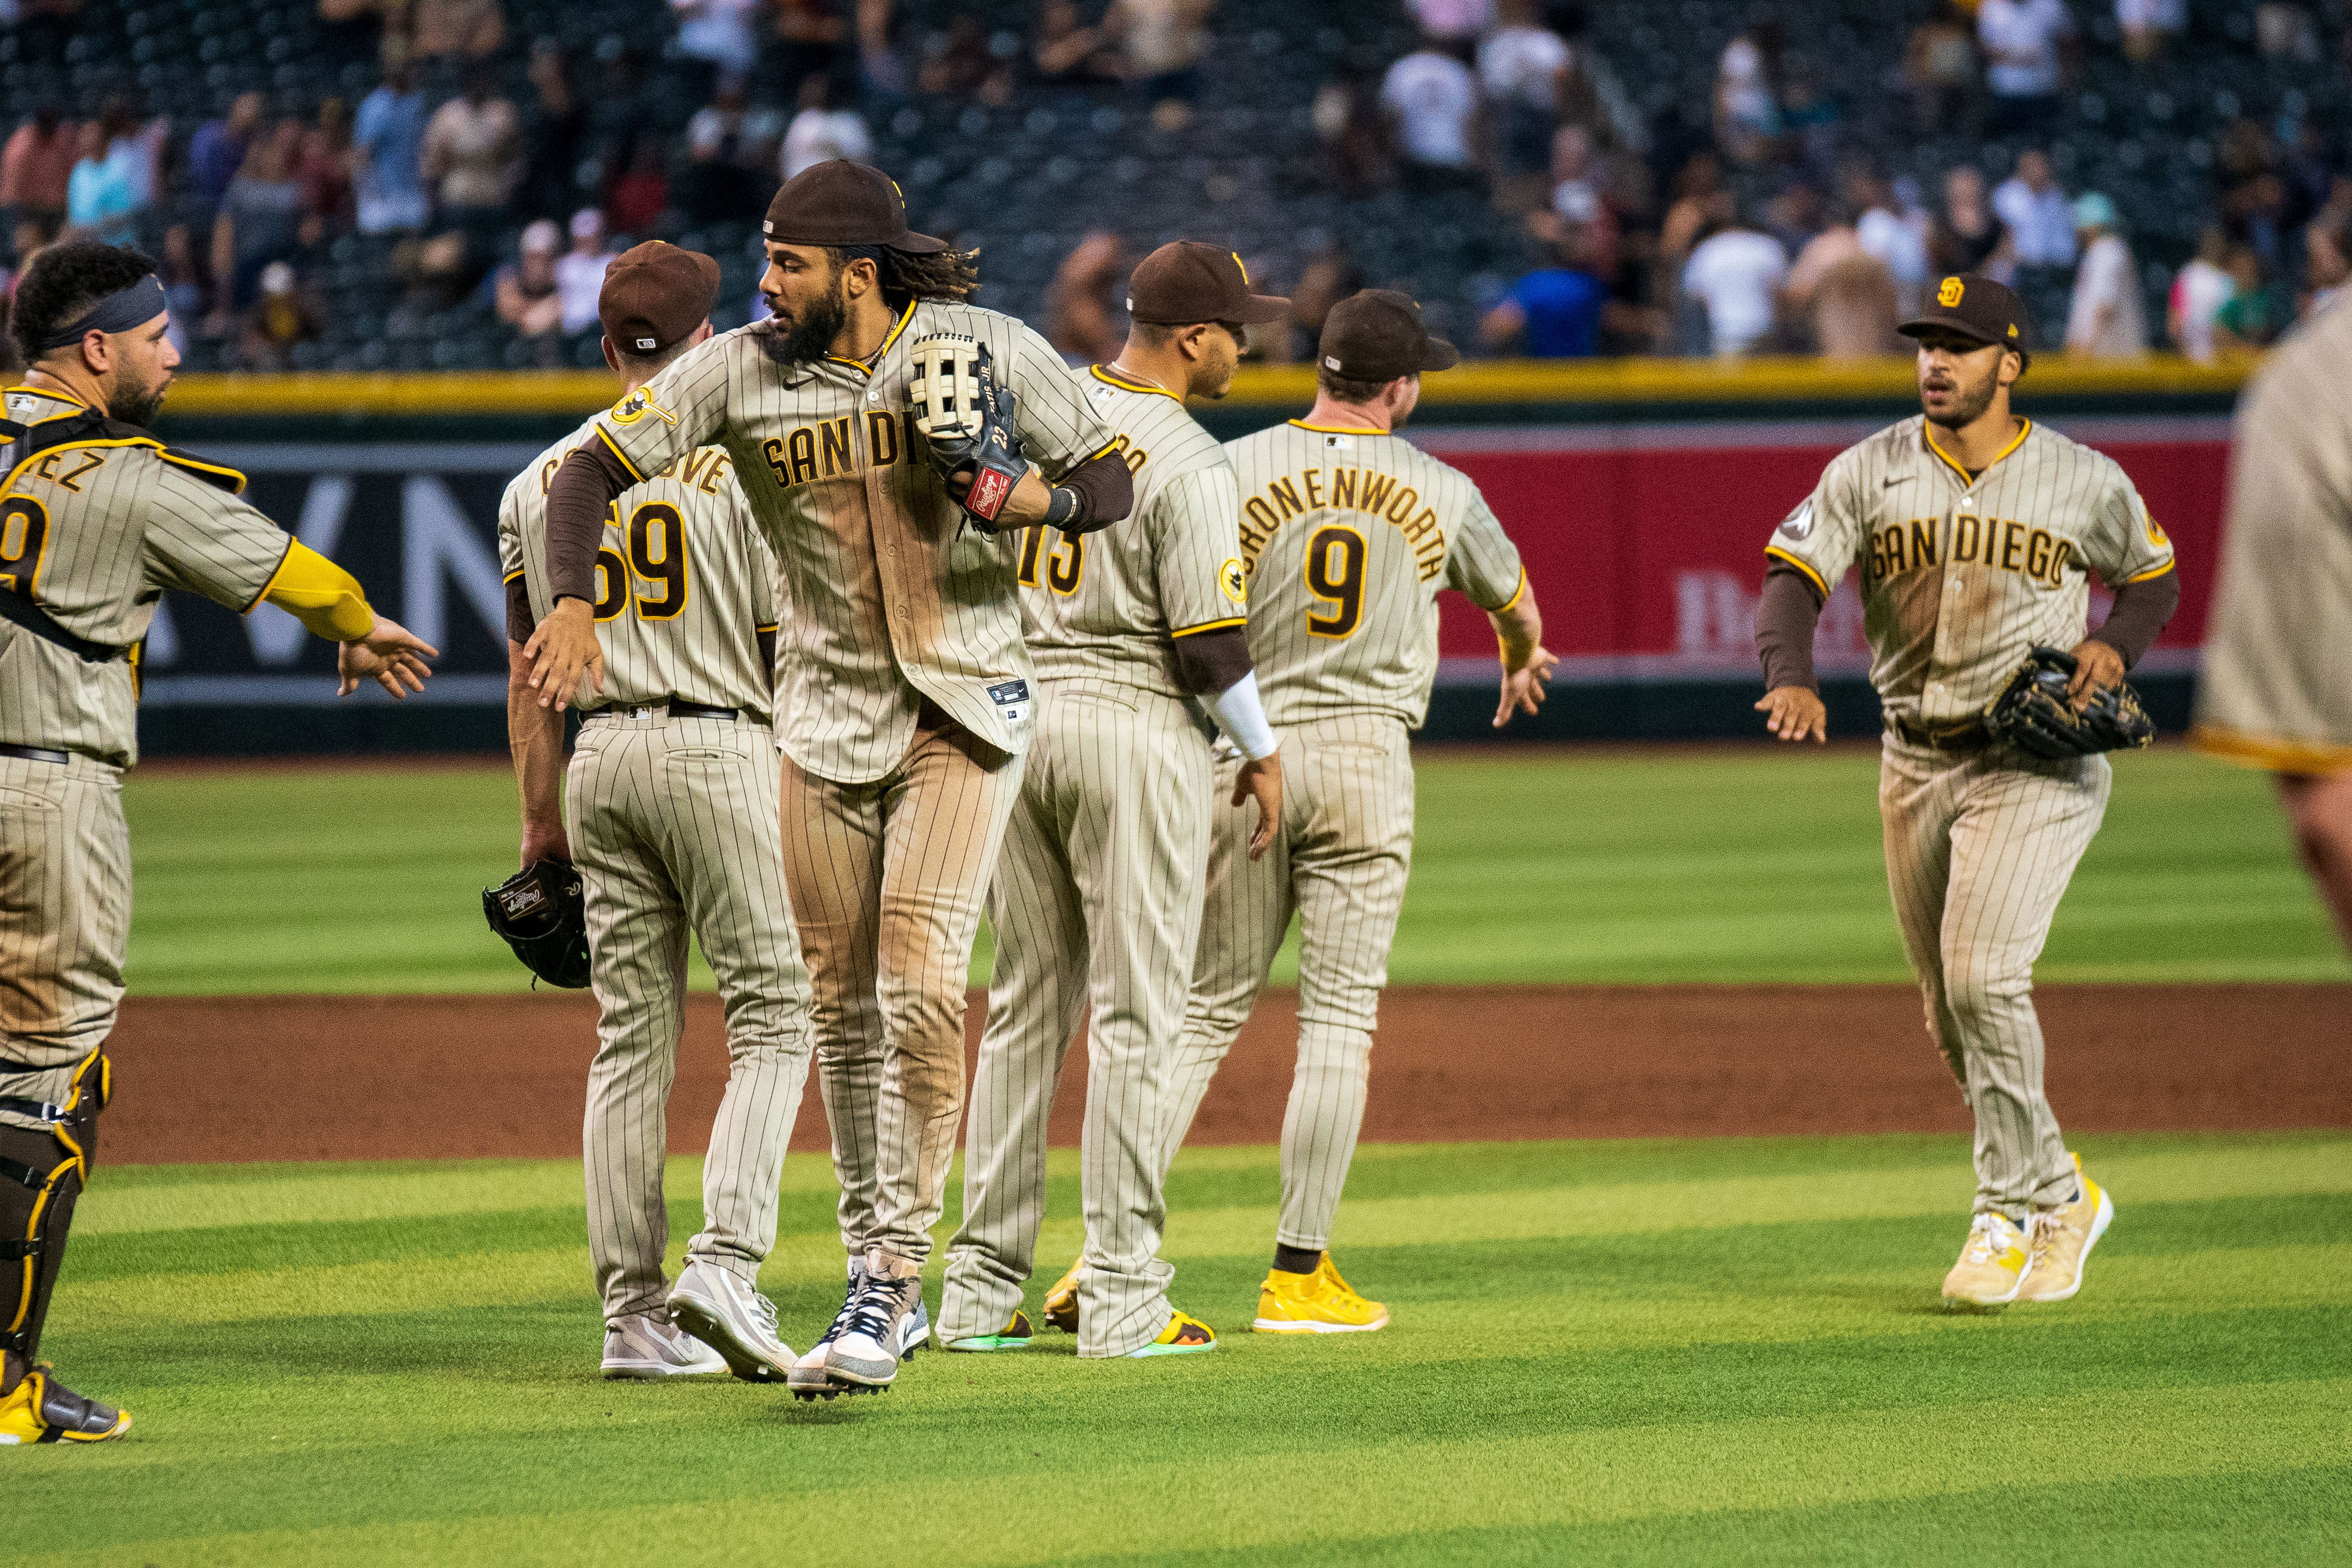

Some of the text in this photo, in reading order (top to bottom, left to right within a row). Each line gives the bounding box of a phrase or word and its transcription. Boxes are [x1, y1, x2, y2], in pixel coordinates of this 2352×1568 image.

[981, 366, 990, 382] JR
[762, 416, 854, 489] SAN
[991, 425, 1008, 450] 23
[23, 448, 105, 494] EZ
[976, 474, 994, 512] Rawlings
[1871, 513, 2072, 587] SAN DIEGO
[1304, 523, 1369, 640] 9
[508, 889, 540, 912] Rawlings
